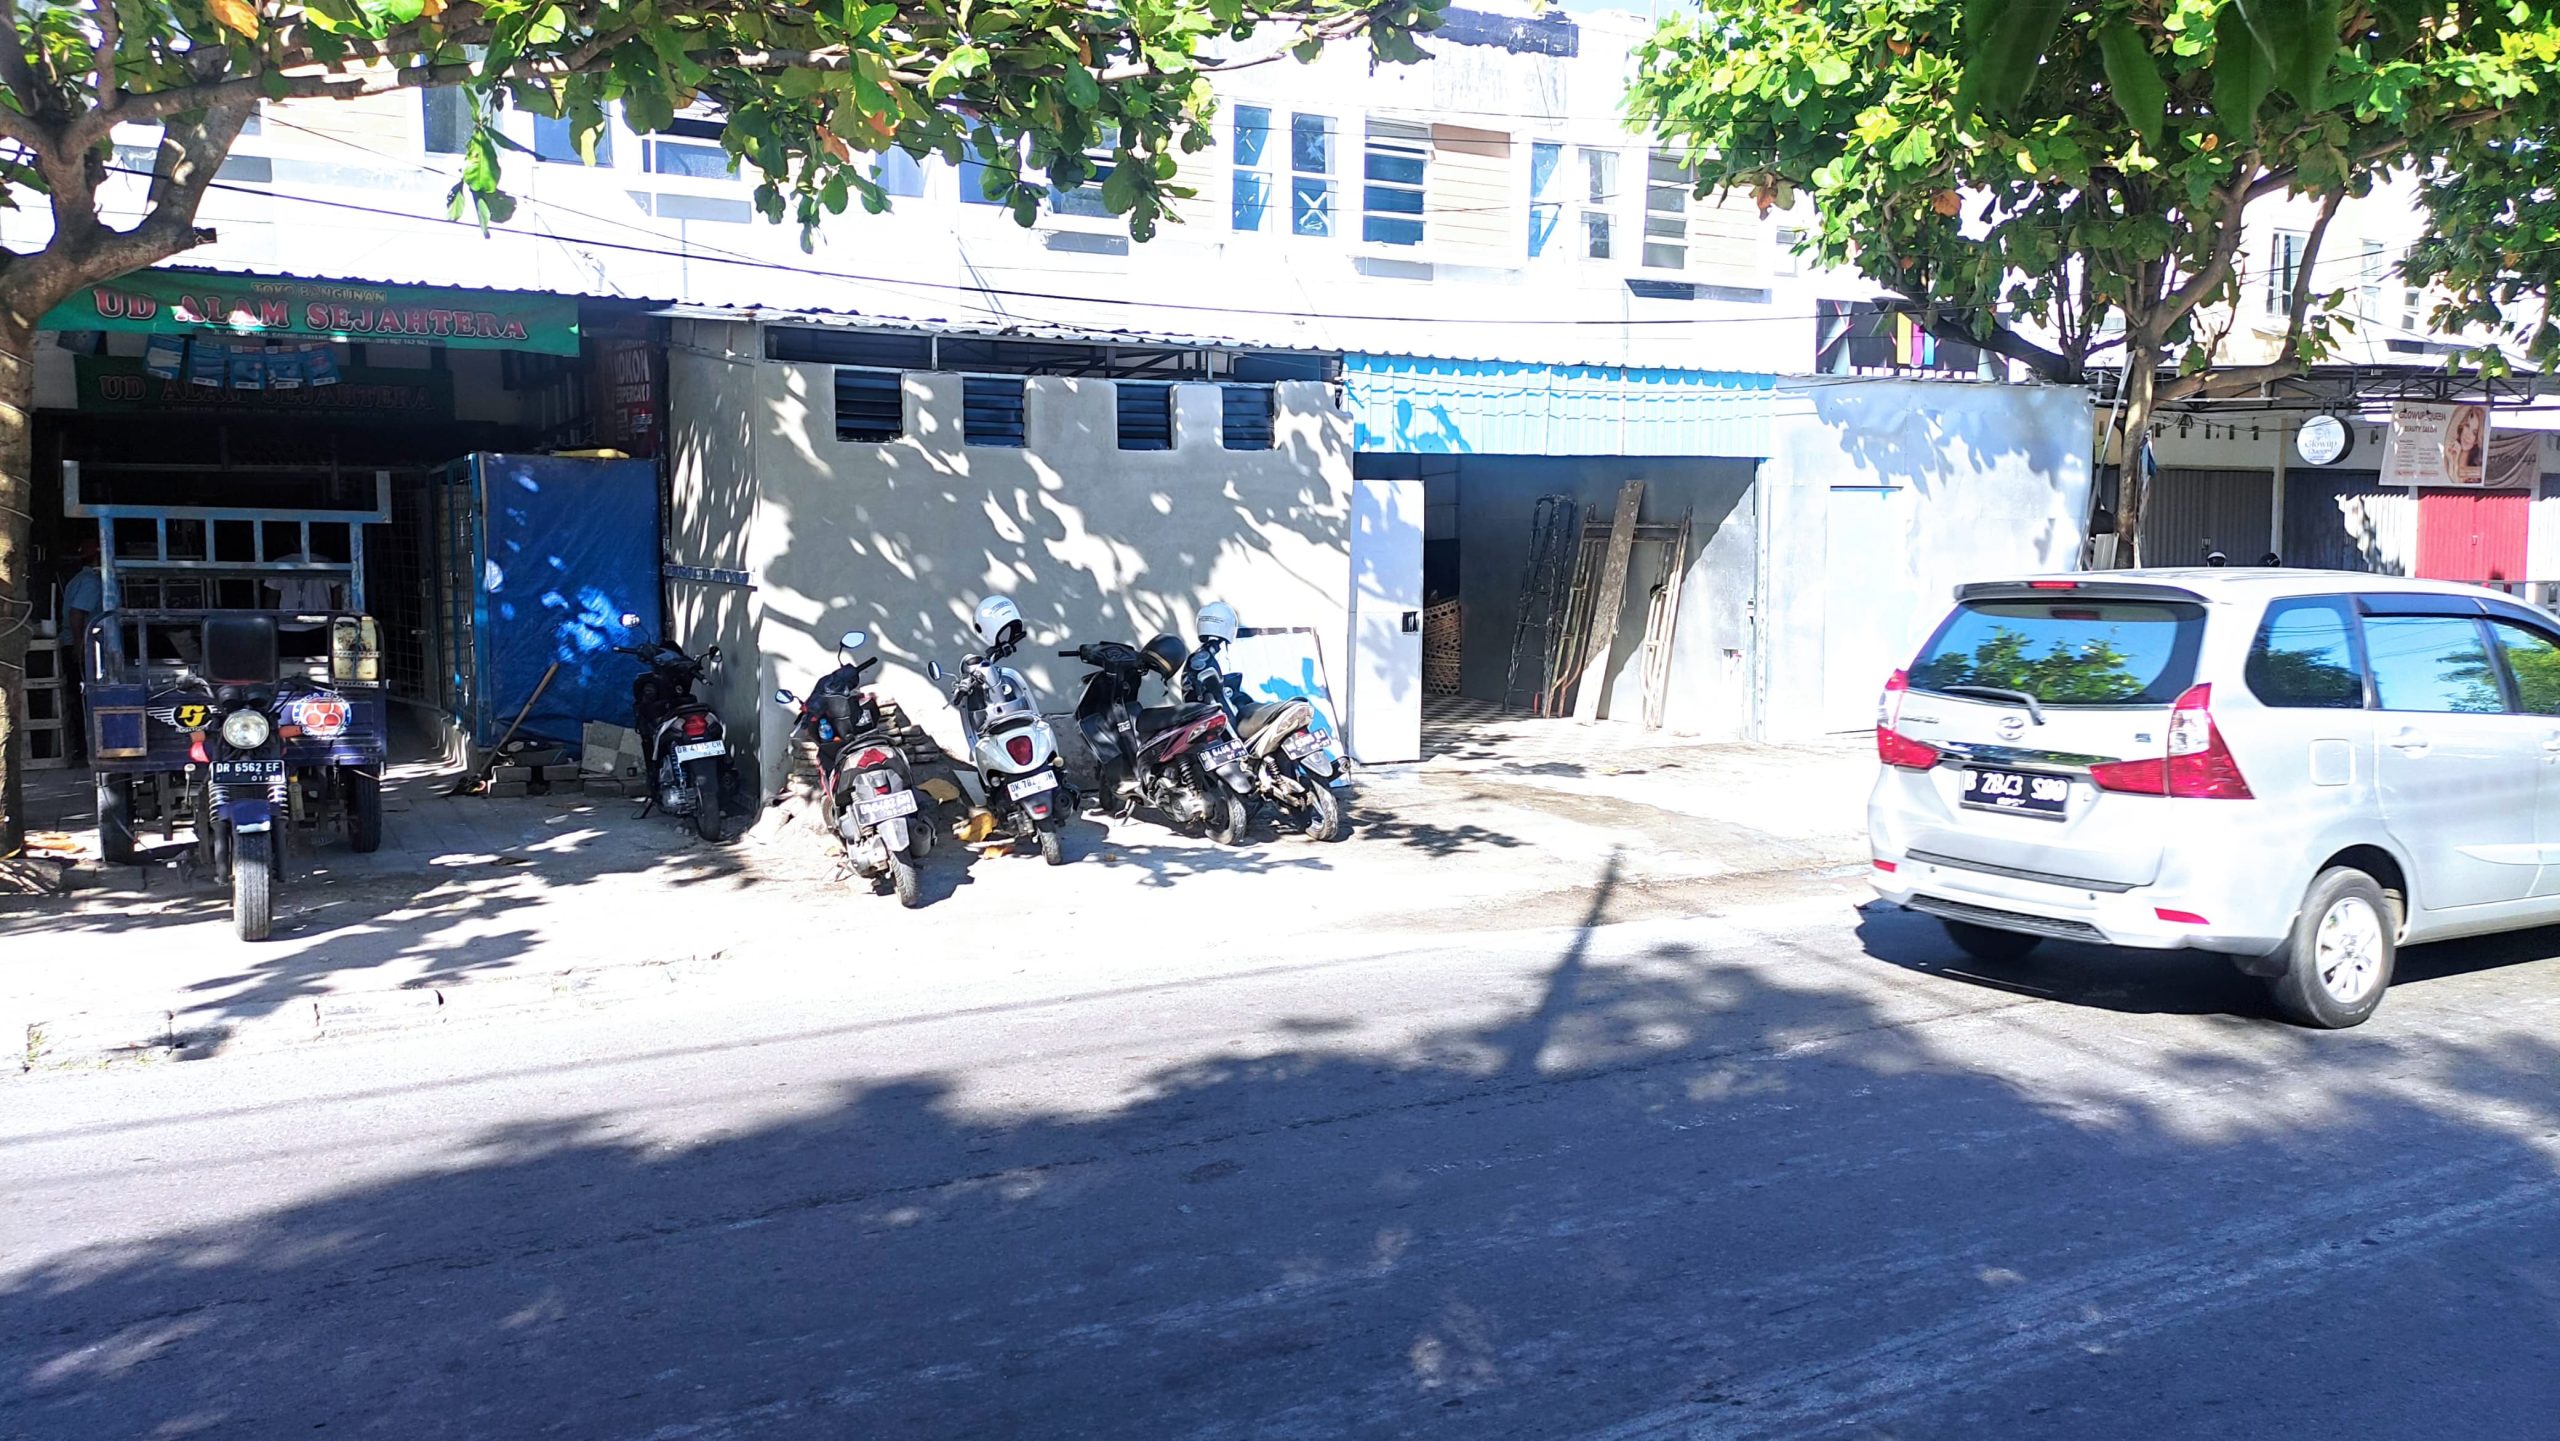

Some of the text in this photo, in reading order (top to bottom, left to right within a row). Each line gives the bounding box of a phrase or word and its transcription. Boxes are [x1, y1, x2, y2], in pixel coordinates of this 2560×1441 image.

[93, 288, 528, 340] UD ALAM SEJAHTERA
[99, 375, 147, 401] UD
[216, 762, 280, 773] DR 6562 EF
[1010, 784, 1021, 793] DK
[1961, 770, 1978, 791] B
[1981, 773, 2023, 796] 2843
